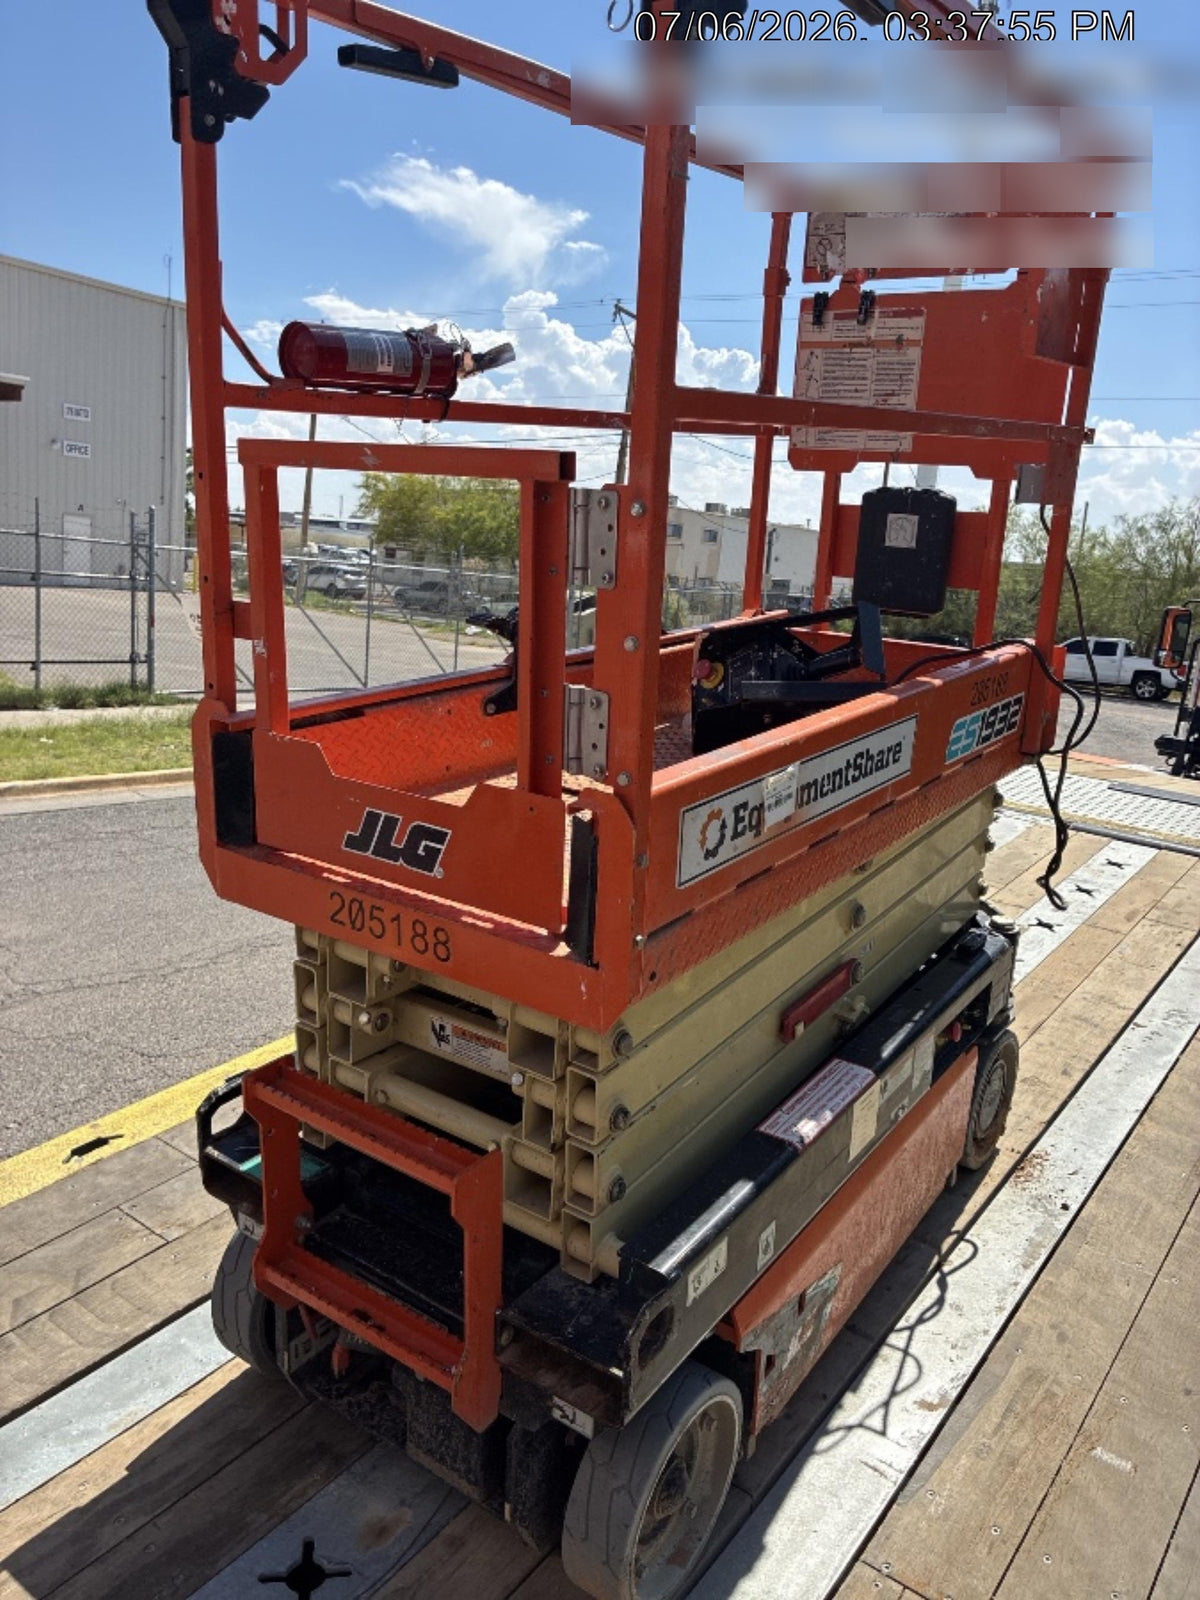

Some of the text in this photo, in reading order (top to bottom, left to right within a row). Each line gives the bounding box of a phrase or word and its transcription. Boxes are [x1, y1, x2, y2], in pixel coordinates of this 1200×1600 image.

[65, 443, 89, 456] OFFICE
[946, 692, 1024, 764] ES1932
[342, 807, 452, 877] JLG
[329, 892, 452, 963] 205188
